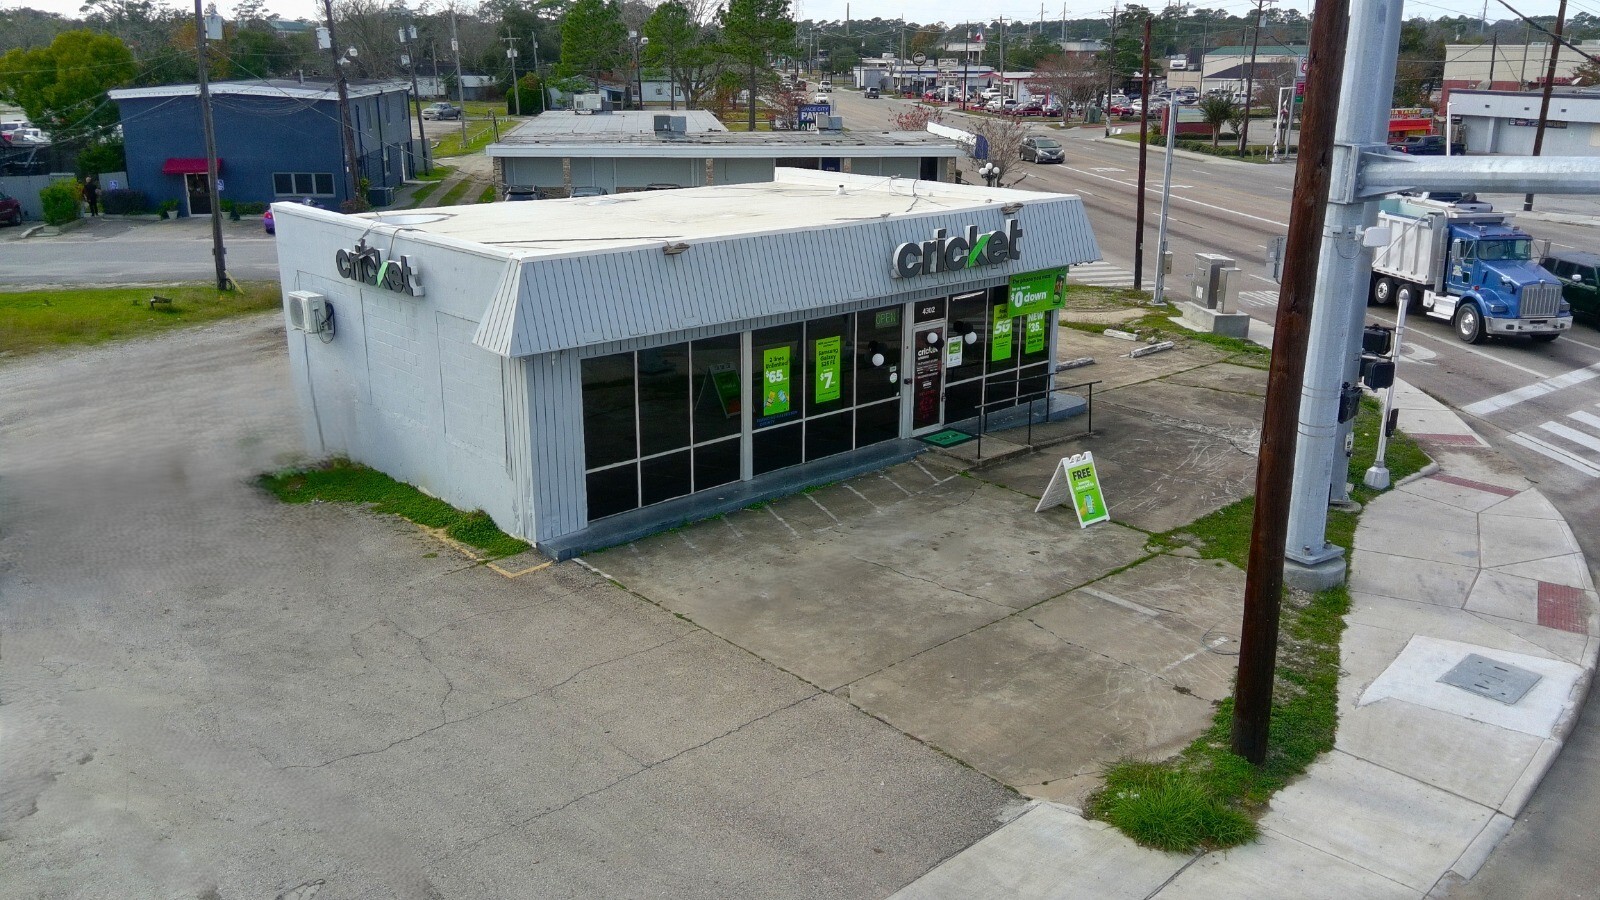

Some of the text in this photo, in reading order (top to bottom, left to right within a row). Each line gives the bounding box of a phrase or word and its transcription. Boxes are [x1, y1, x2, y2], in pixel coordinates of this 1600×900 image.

[893, 218, 1023, 278] cricket
[336, 245, 424, 297] cricket
[1011, 290, 1046, 308] $0 down
[875, 311, 896, 325] OPEN
[922, 306, 936, 315] 4302
[1028, 312, 1044, 322] NEW
[994, 319, 1011, 335] 5G
[765, 369, 784, 384] $65
[820, 371, 833, 389] $7
[1072, 467, 1091, 481] FREE
